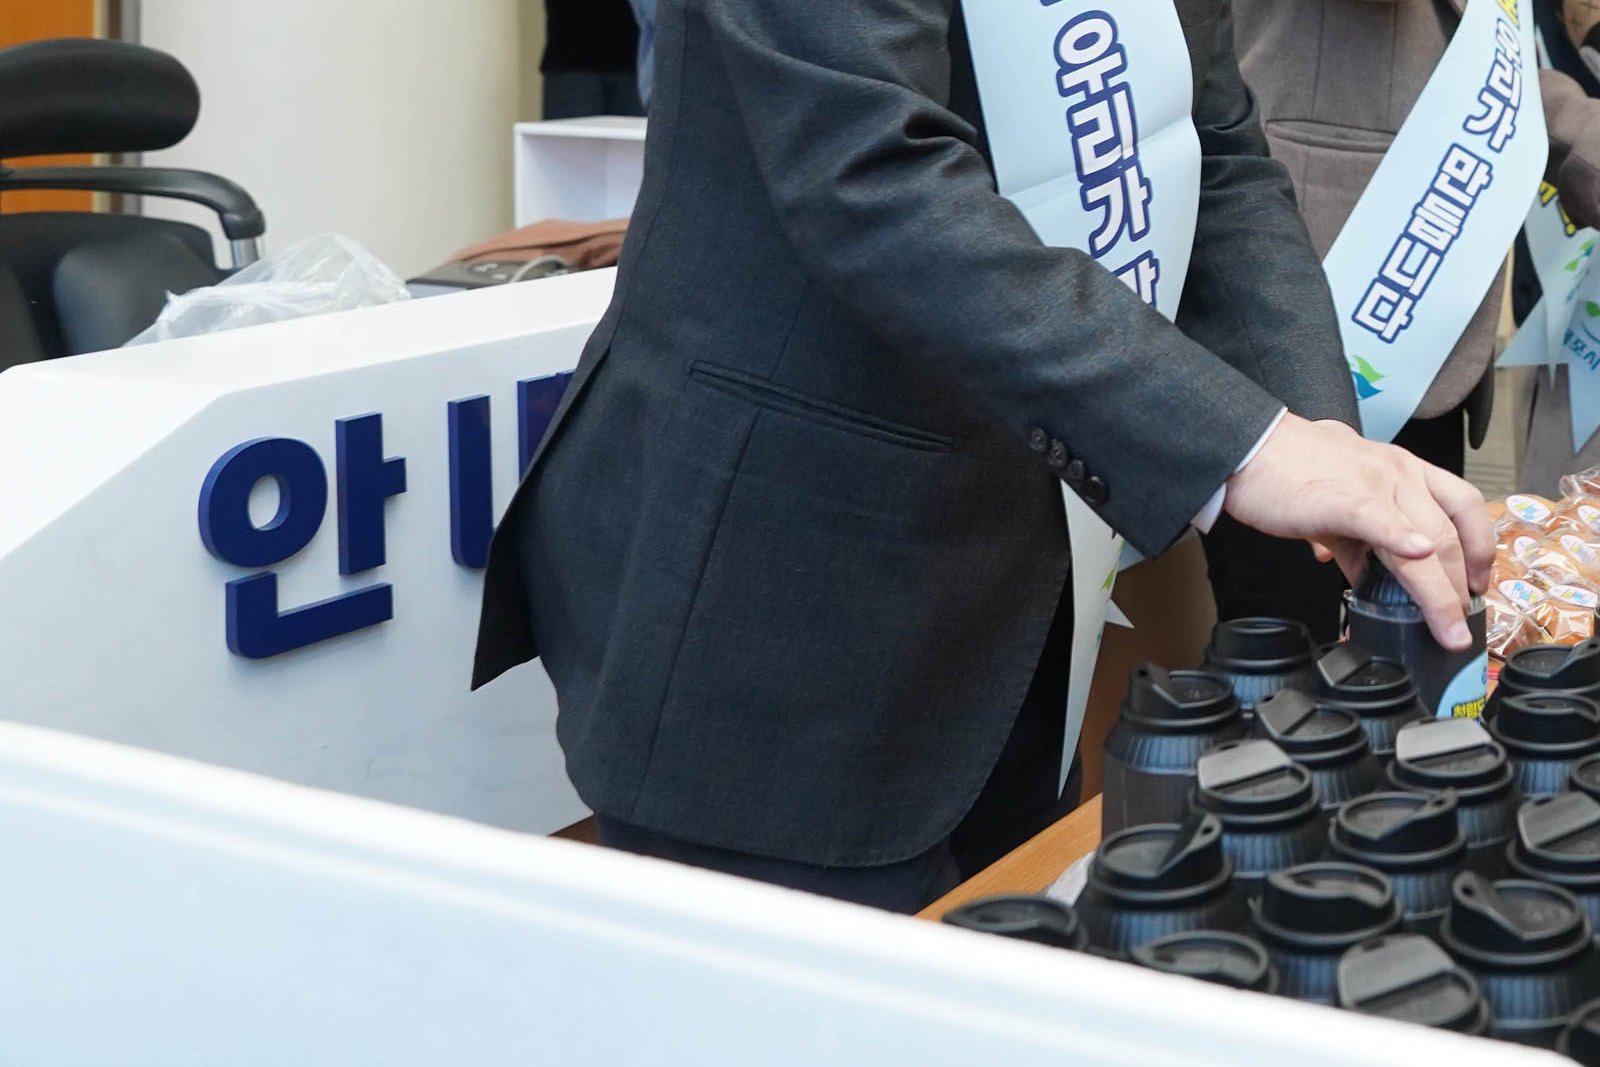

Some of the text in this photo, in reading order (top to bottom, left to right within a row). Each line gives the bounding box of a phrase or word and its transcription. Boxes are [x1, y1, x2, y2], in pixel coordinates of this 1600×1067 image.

[1053, 9, 1153, 260] 우리가
[1462, 21, 1524, 153] 우리가
[1351, 142, 1493, 344] 만듭니다
